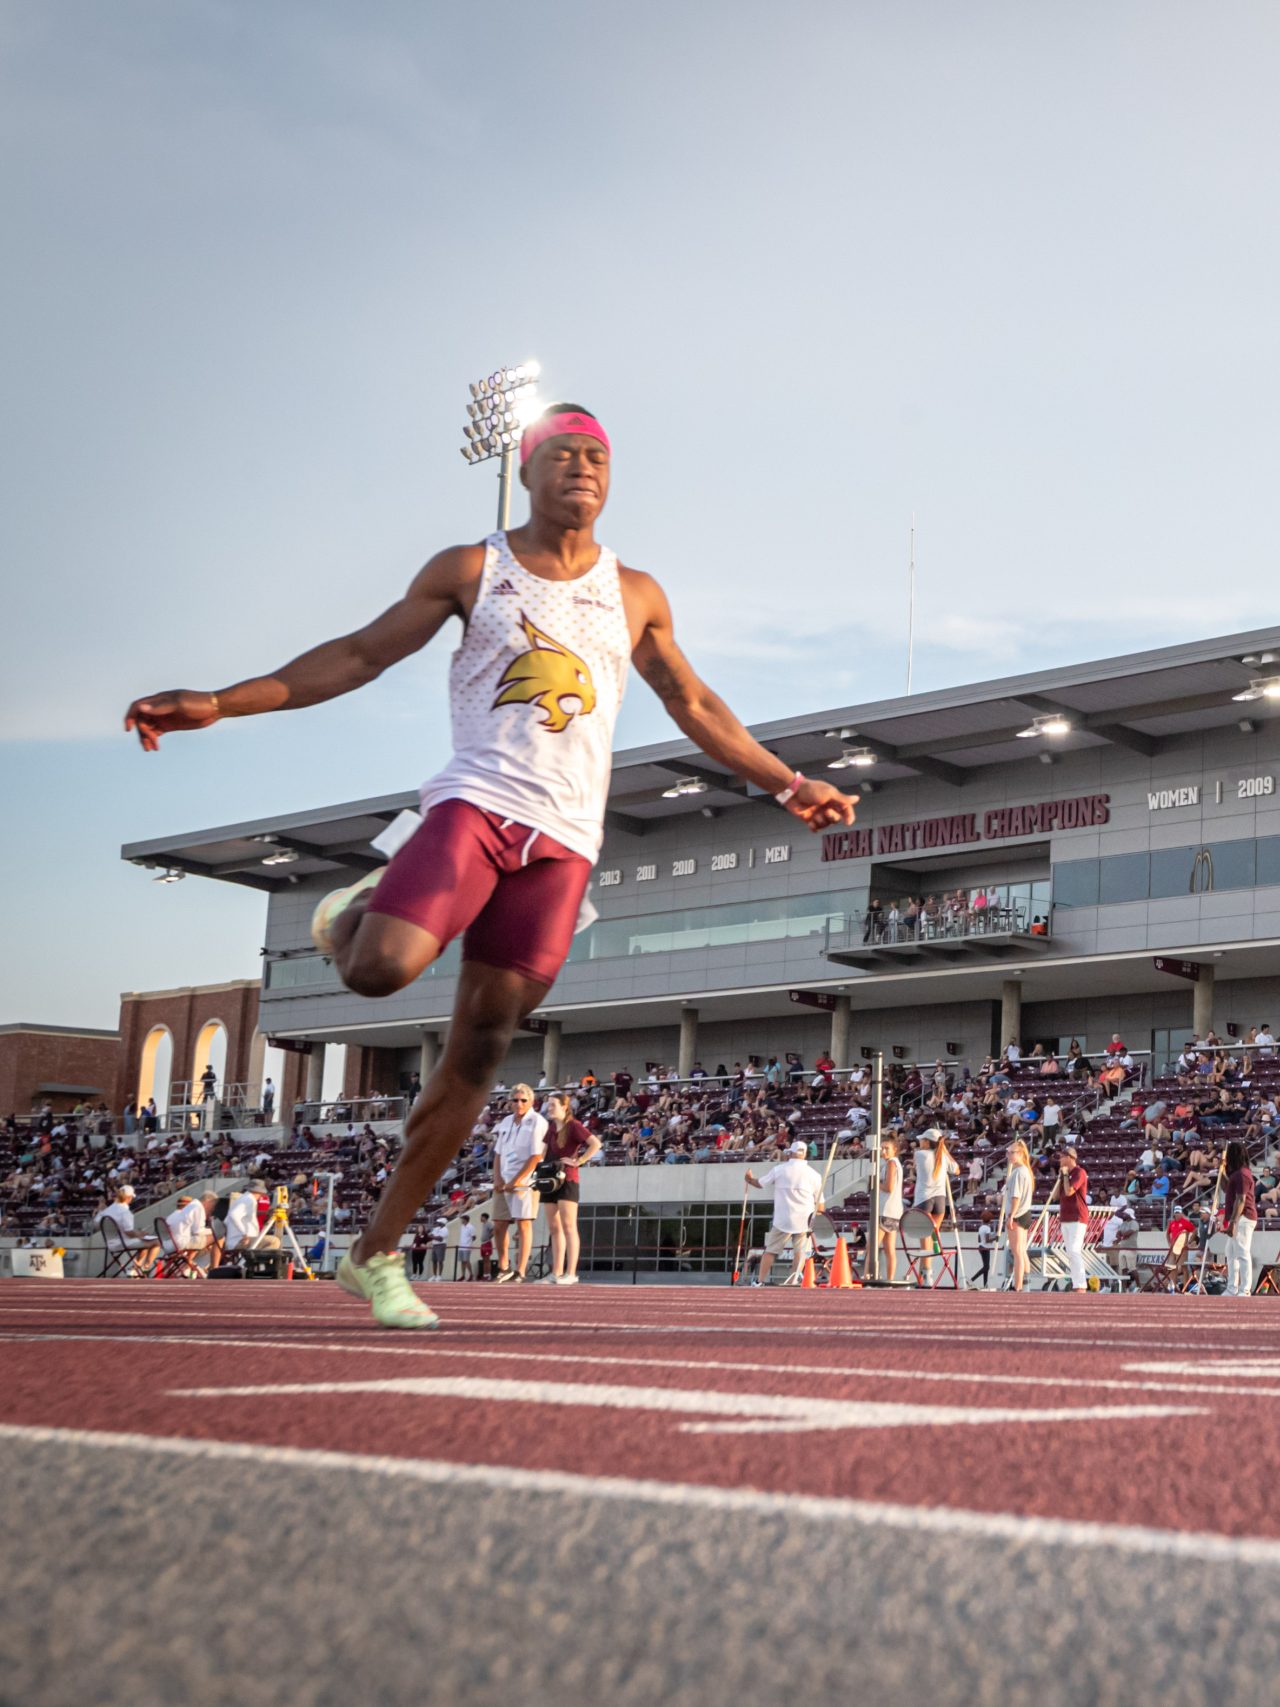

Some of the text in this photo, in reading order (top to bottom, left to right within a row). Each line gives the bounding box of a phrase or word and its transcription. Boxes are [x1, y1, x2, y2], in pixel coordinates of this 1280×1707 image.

[1147, 786, 1199, 810] WOMEN
[1237, 775, 1274, 798] 2009
[821, 793, 1111, 862] NCAA NATIONAL CHAMPIONS
[599, 845, 791, 886] 2013 2011 2010 2009 MEN
